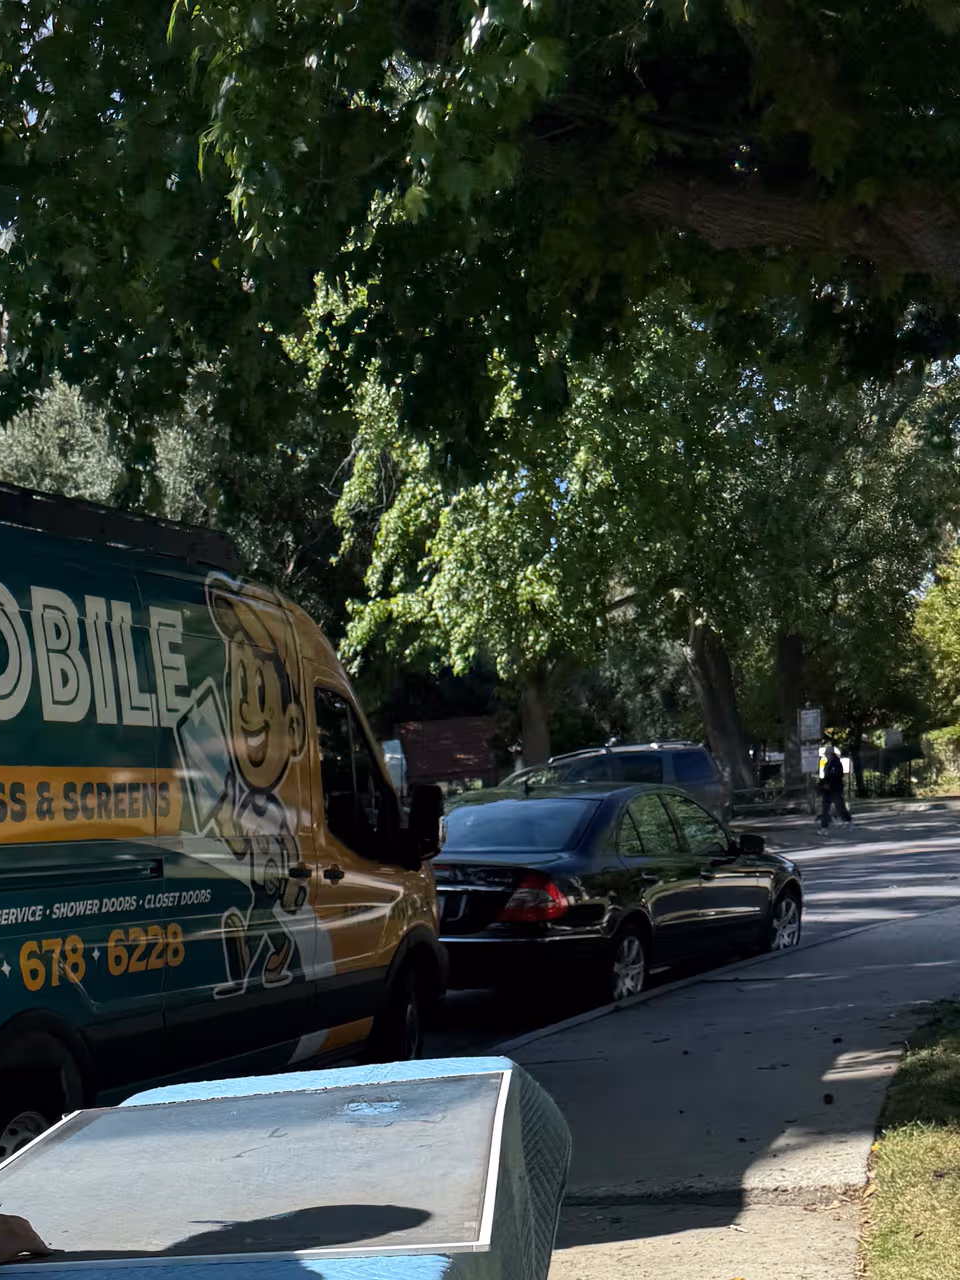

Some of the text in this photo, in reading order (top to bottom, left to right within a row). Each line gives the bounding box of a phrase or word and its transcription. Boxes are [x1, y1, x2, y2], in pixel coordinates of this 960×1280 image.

[36, 781, 55, 821] &
[63, 781, 170, 820] SCREENS
[52, 898, 99, 919] SHOWER
[101, 895, 137, 914] DOORS
[144, 892, 180, 909] CLOSET
[181, 889, 211, 906] DOORS
[20, 934, 86, 992] 678
[107, 923, 185, 976] 6228
